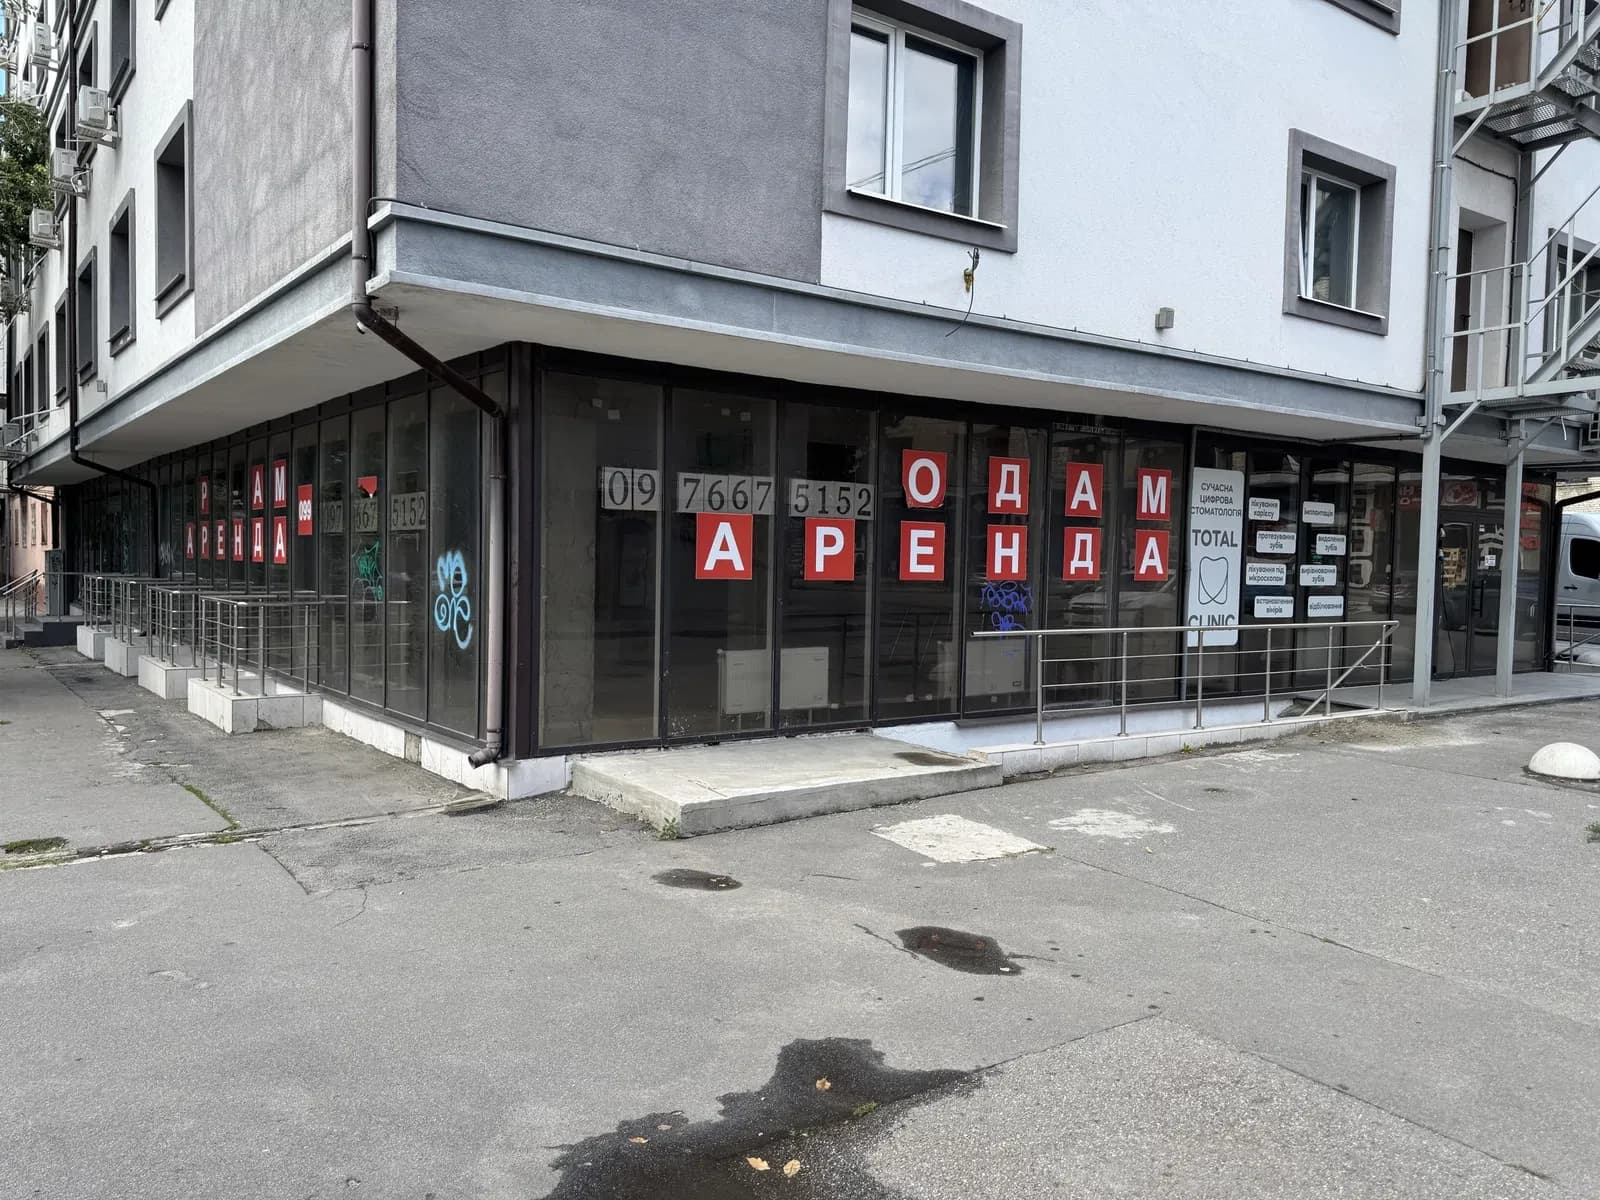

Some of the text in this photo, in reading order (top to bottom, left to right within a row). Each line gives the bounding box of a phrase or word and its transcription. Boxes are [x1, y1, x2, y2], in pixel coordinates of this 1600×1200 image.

[1200, 482, 1234, 493] СУЧАСНА
[1199, 494, 1234, 505] ЦИФРОВА
[1191, 506, 1242, 518] СТОМАТОЛОГІЯ
[186, 522, 286, 559] АРЕНДА
[1191, 528, 1239, 548] TOTAL
[703, 521, 1165, 575] АРЕНДА
